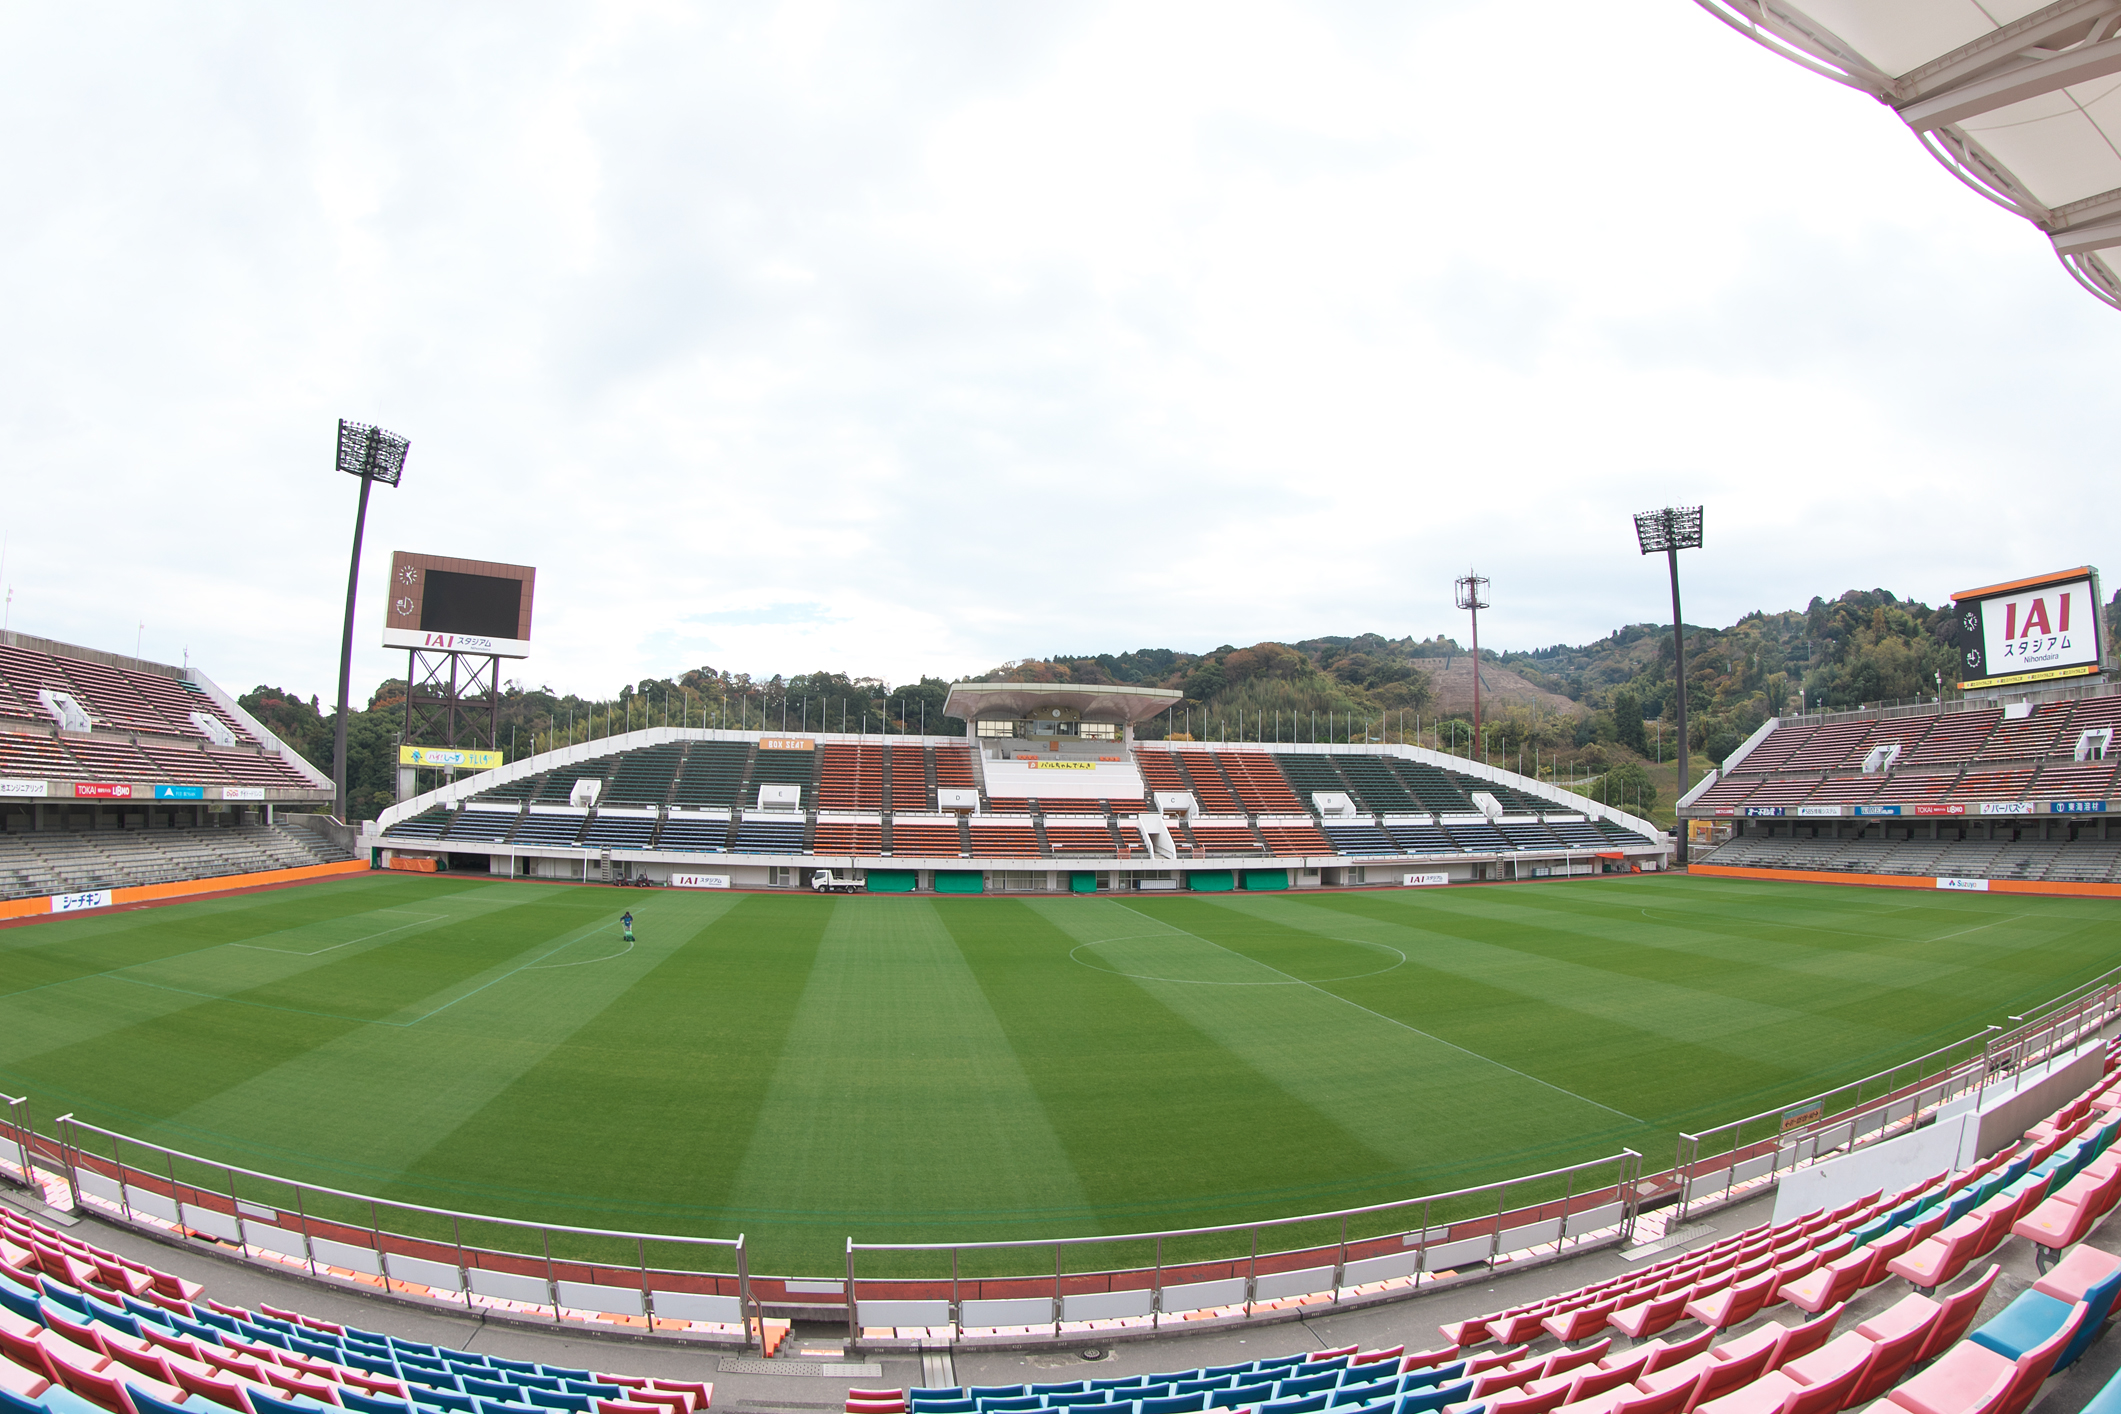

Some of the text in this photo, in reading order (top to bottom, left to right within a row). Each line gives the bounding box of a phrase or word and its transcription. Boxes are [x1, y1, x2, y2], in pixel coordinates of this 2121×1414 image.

[2005, 592, 2070, 641] IAI
[425, 633, 491, 648] IAI スタジアム
[2004, 635, 2071, 657] スタジアム
[2023, 653, 2059, 664] Nihondaira
[786, 741, 804, 749] SEAT
[78, 785, 97, 795] TOKAI
[112, 785, 130, 796] LIBMO
[680, 877, 698, 885] IAI
[1957, 880, 1977, 888] Suzuyo
[63, 893, 101, 909] シーチキン
